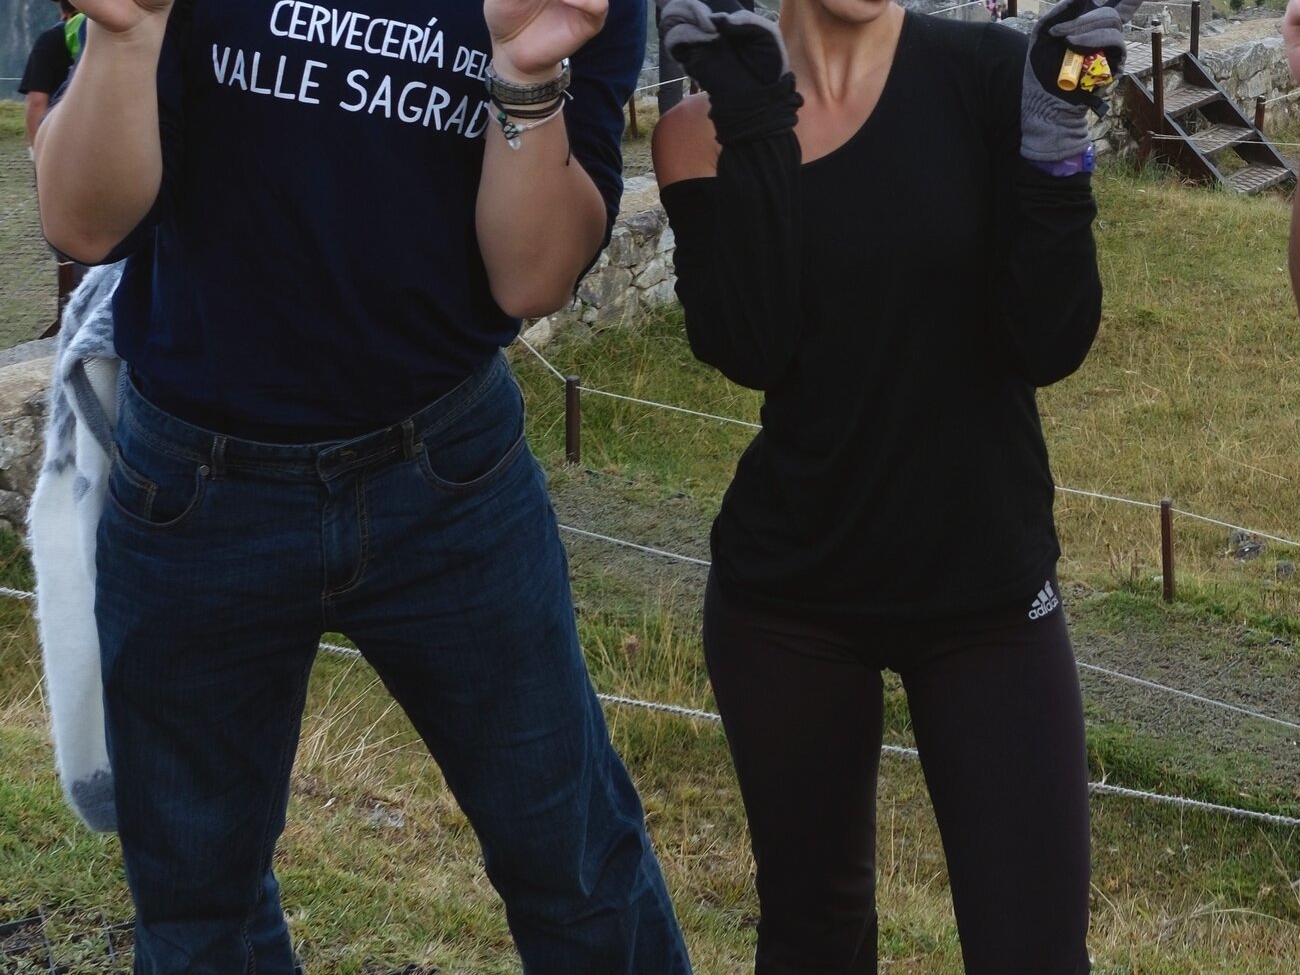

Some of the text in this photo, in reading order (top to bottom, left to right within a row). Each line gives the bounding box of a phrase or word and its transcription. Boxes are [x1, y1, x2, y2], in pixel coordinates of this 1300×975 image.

[452, 46, 486, 82] DEL
[211, 43, 488, 139] VALLE SAGRAD
[1028, 595, 1059, 620] adidas
